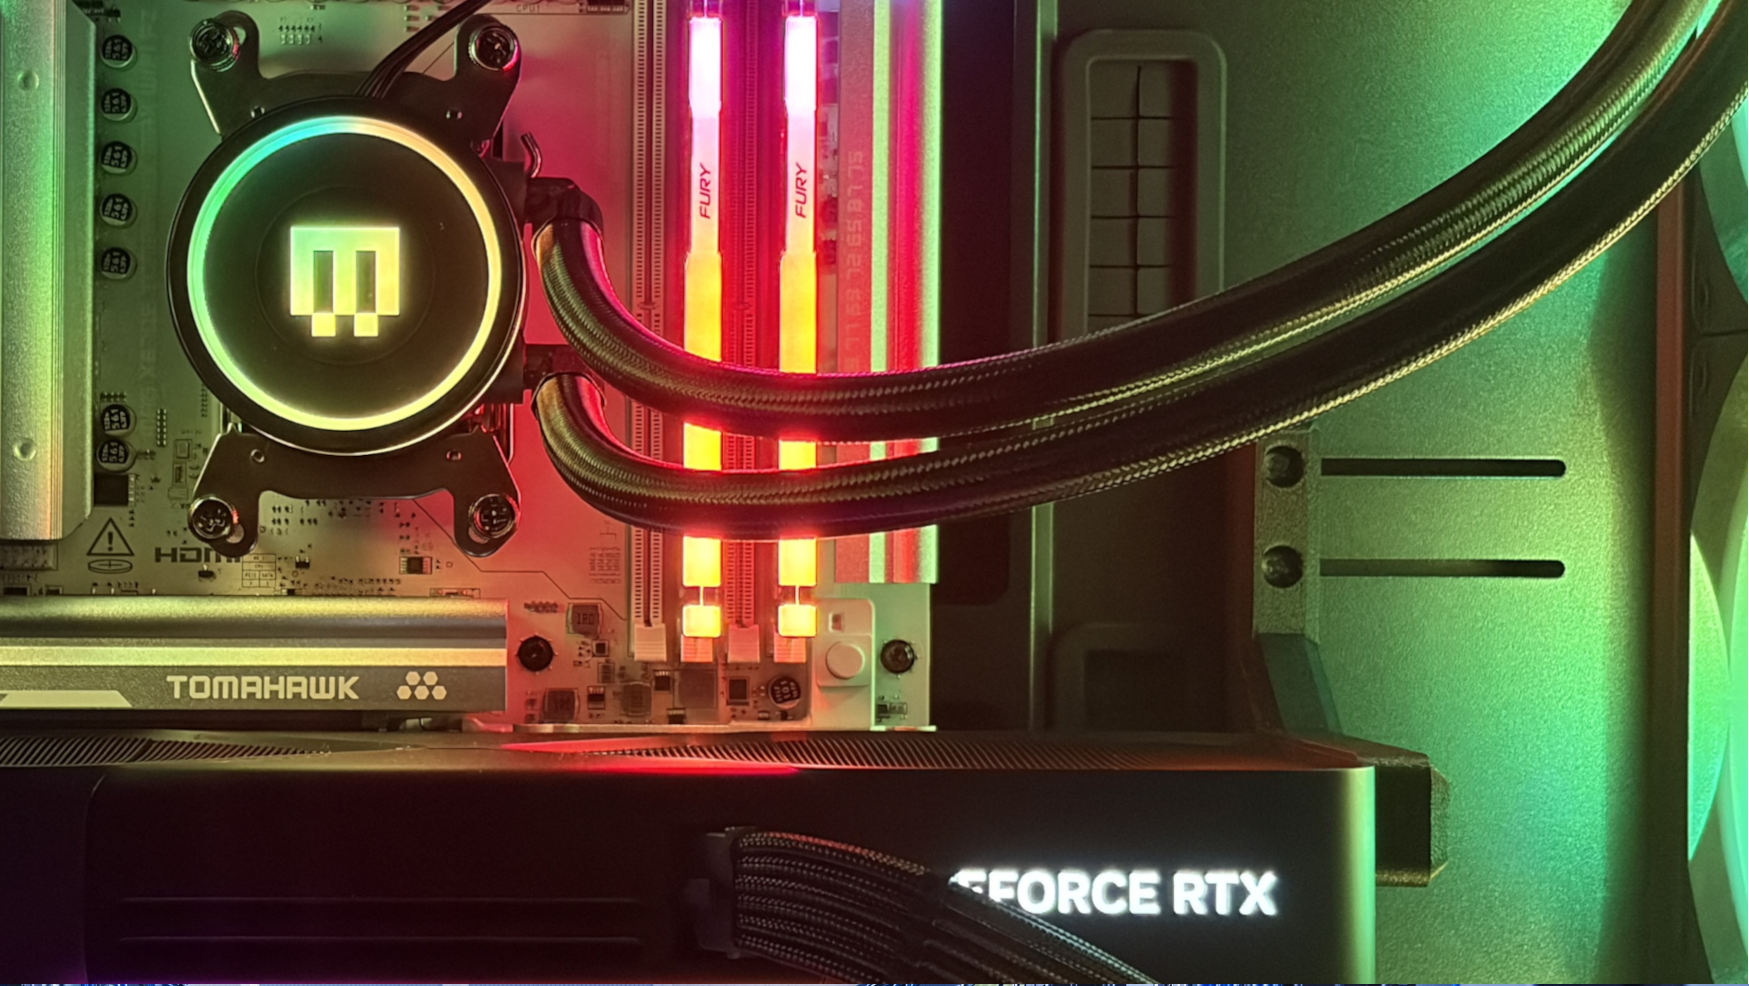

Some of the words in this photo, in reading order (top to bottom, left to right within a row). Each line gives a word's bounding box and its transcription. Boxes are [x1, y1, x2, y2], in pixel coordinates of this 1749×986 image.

[699, 162, 711, 219] FURY
[795, 161, 807, 218] FURY
[154, 546, 241, 564] HDM
[166, 675, 360, 700] TOMAHAWK
[1172, 869, 1278, 916] RTX
